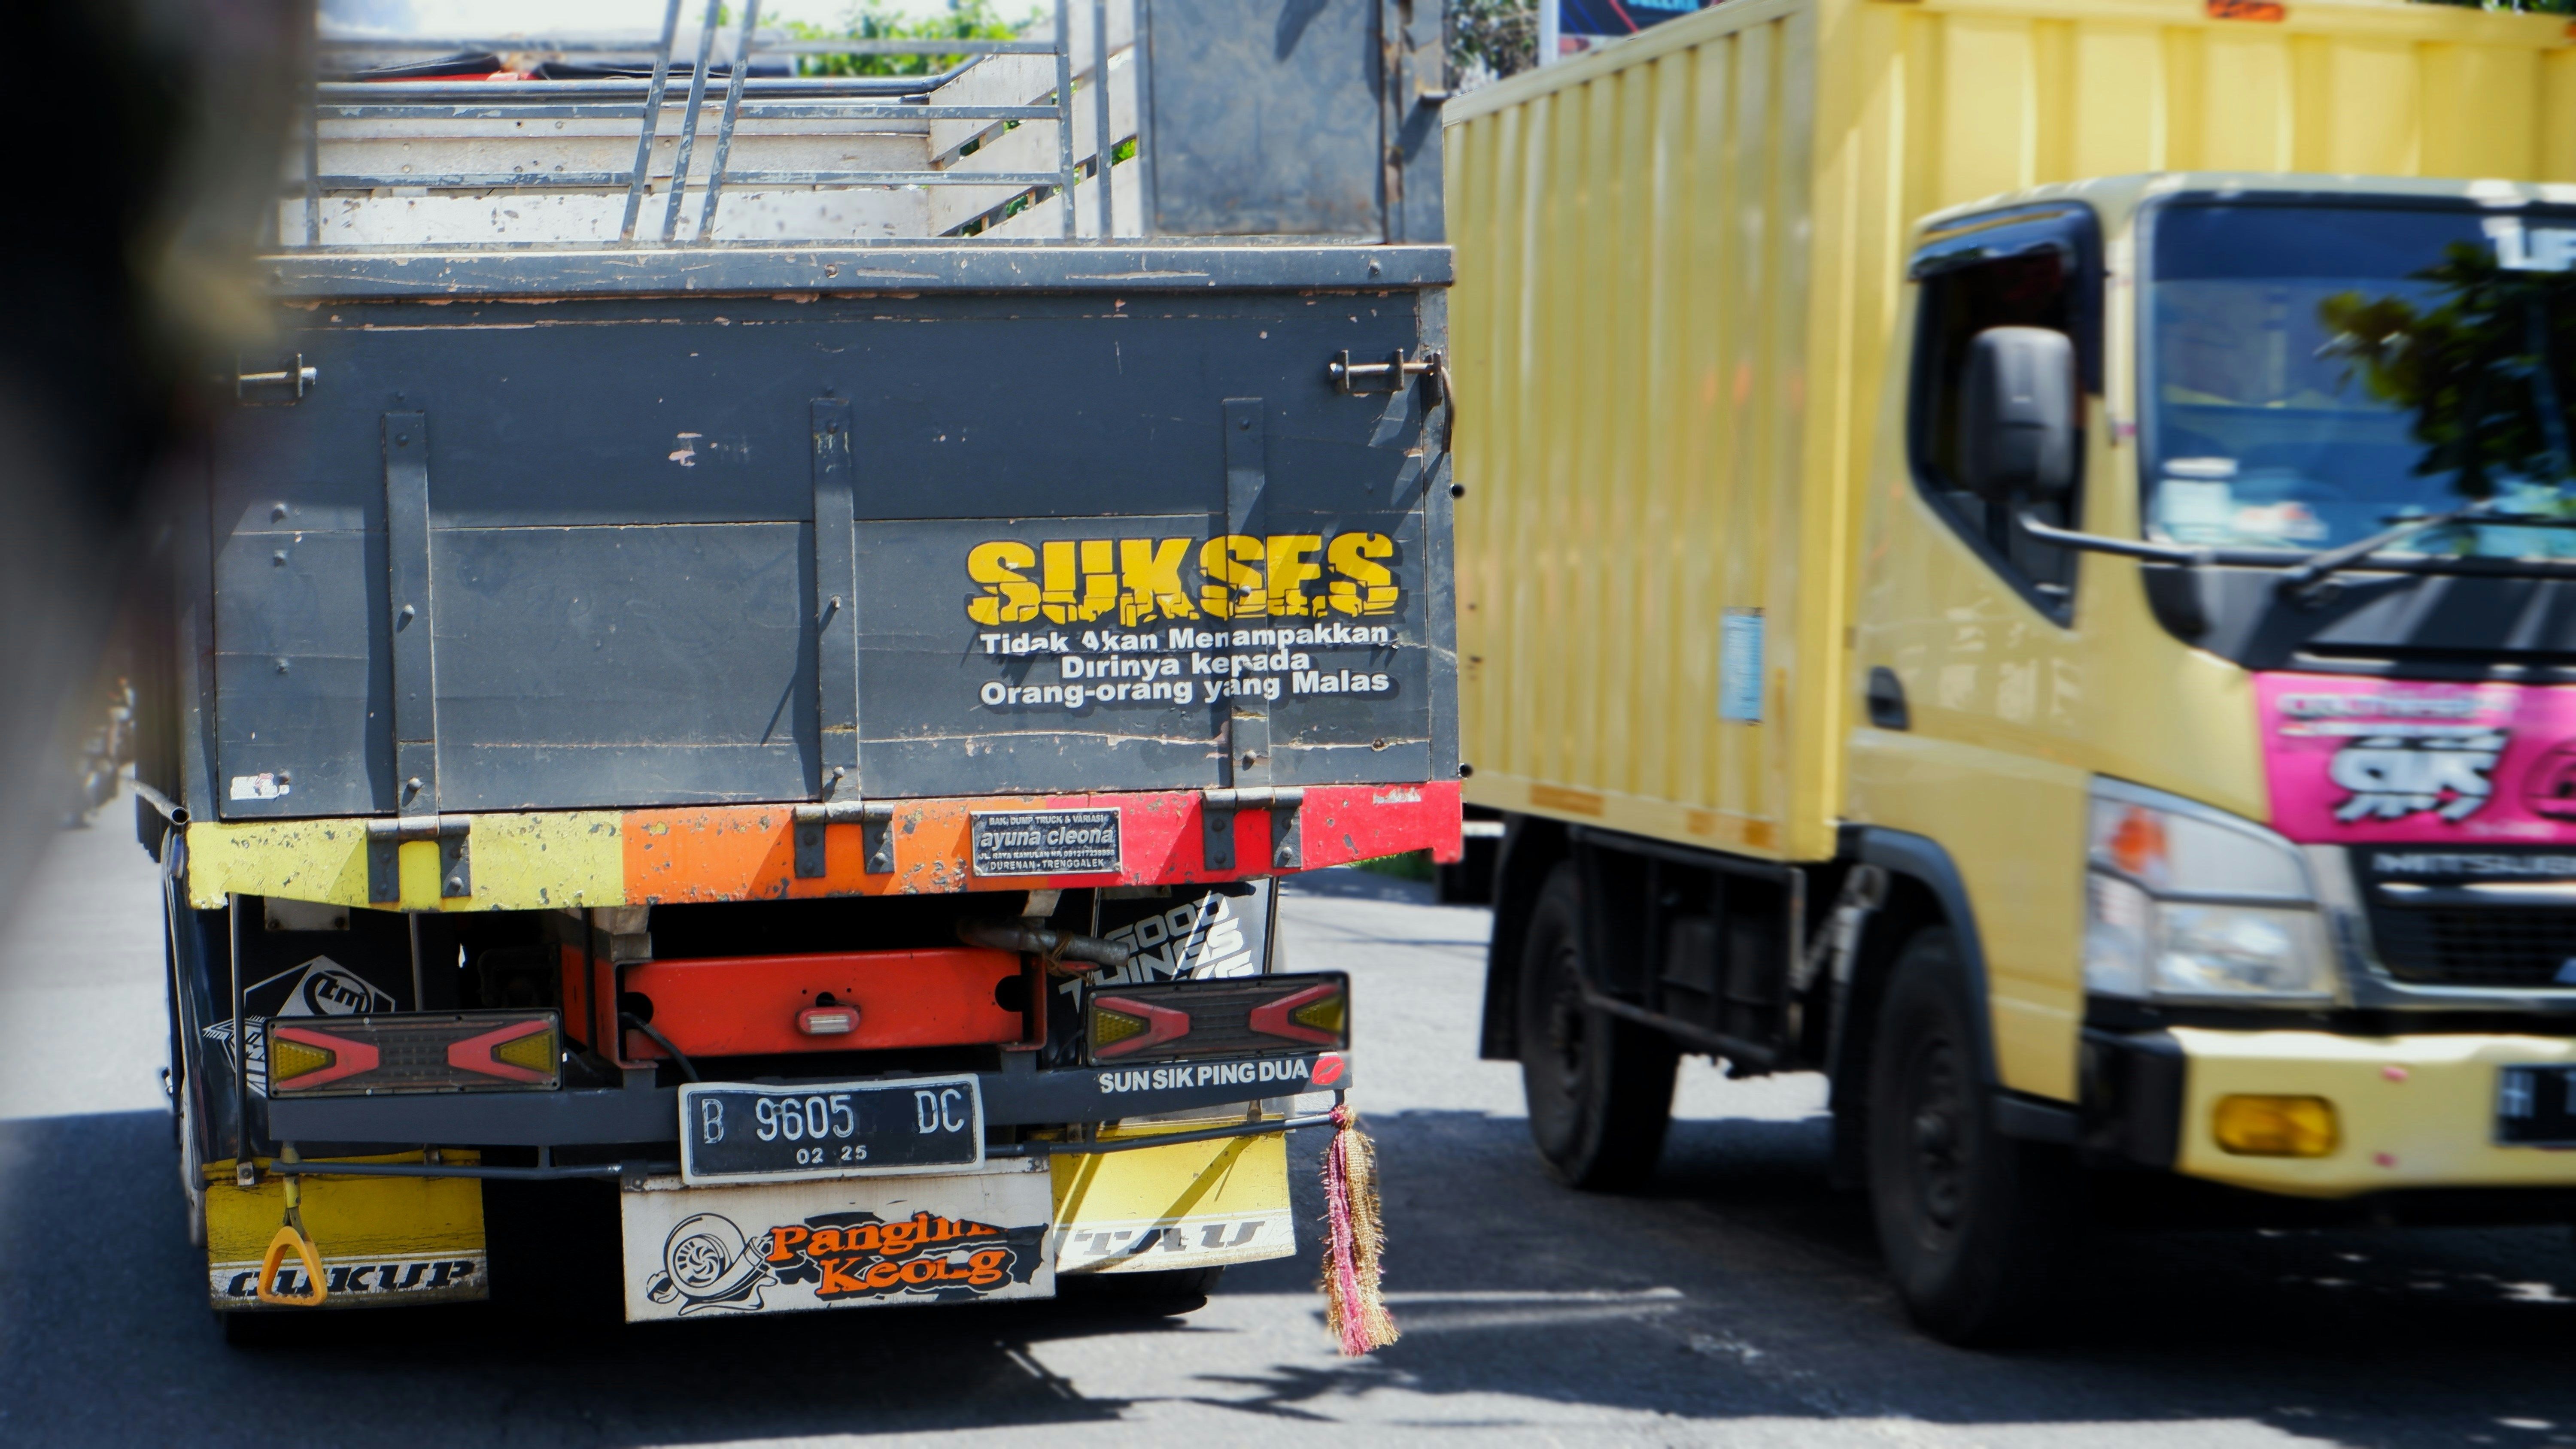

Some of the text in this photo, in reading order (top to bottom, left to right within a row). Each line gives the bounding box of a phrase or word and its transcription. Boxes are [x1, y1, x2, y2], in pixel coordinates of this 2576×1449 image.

[967, 533, 1399, 627] SUKSES
[980, 631, 1069, 654] Tidak
[1169, 622, 1388, 649] Menampakkan
[1062, 649, 1310, 680] Dirinya kepada
[980, 670, 1389, 709] Orang-orang yang Malas
[1010, 816, 1033, 825] DUMP
[1035, 815, 1063, 825] TRUCK
[1065, 815, 1071, 824] &
[1072, 814, 1104, 823] VARIASI
[980, 827, 1114, 851] ayuna cleona
[990, 861, 1036, 871] DURENAN
[1042, 858, 1104, 869] TRENGGALEK
[1099, 1058, 1309, 1094] SUN SIK PING DUA
[702, 1089, 964, 1144] B 9605 DC
[796, 1145, 867, 1164] 02 25
